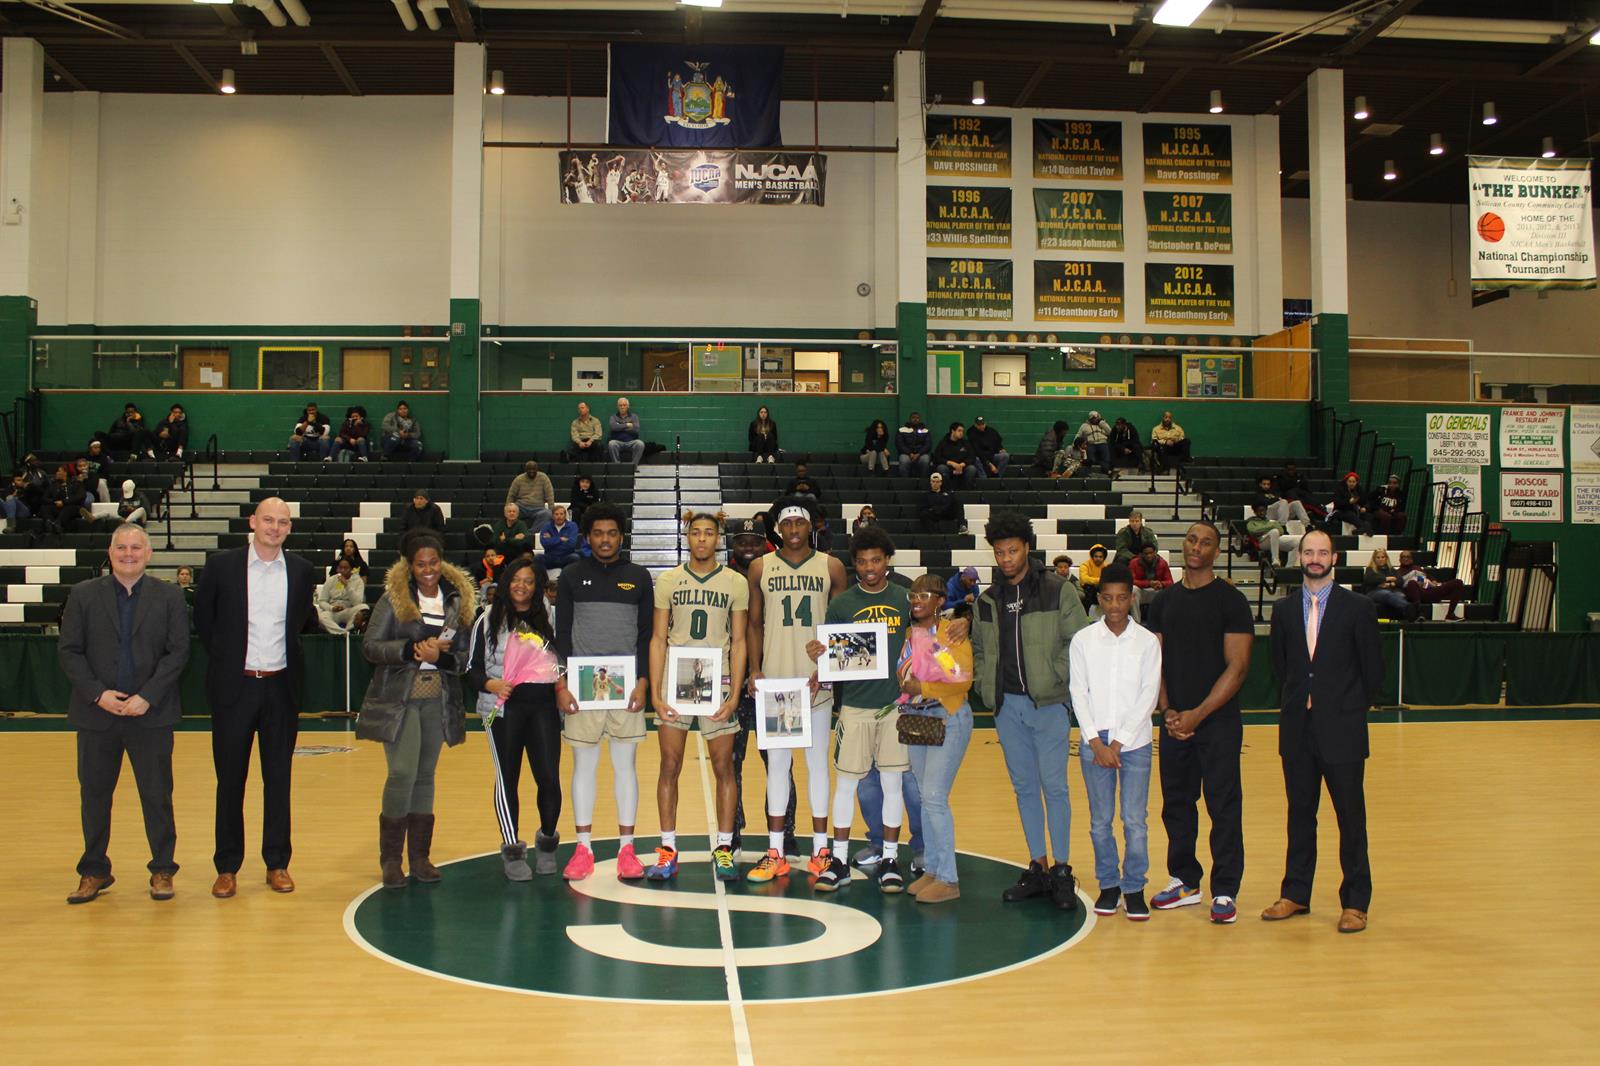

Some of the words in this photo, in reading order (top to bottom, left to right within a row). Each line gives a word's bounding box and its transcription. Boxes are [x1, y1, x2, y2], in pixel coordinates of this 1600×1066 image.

[953, 118, 980, 130] 1992
[1064, 122, 1092, 134] 1993
[1174, 128, 1201, 140] 1995
[735, 164, 818, 180] NJCAA
[934, 162, 954, 170] DAVE
[955, 162, 998, 172] POSSINGER
[1058, 165, 1087, 175] Donald
[1089, 166, 1115, 176] Taylor
[1157, 170, 1177, 179] Dave
[1179, 170, 1220, 181] Possinger
[735, 181, 762, 189] MEN'S
[952, 190, 980, 203] 1996
[1063, 192, 1094, 204] 2007
[1173, 195, 1204, 208] 2007
[1504, 200, 1525, 208] County
[943, 234, 968, 243] Willie
[969, 234, 1008, 244] Spellman
[1059, 239, 1082, 247] Jason
[1083, 239, 1116, 248] Johnson
[1478, 251, 1518, 261] National
[1521, 252, 1588, 263] Championship
[951, 260, 983, 273] 2008
[1065, 263, 1092, 276] 2011
[1506, 264, 1566, 274] Tournament
[1175, 267, 1203, 279] 2012
[1038, 308, 1051, 316] #11
[1053, 307, 1098, 317] Cleanthony
[1099, 308, 1118, 318] Early
[1150, 310, 1162, 318] #11
[1164, 310, 1207, 320] Cleanthony
[1209, 311, 1228, 320] Early
[1430, 416, 1443, 430] GO
[1447, 416, 1488, 430] GENERALS
[1515, 478, 1548, 486] ROSCOE
[1504, 489, 1536, 497] LUMBER
[1538, 489, 1559, 497] YARD
[768, 575, 824, 593] SULLIVAN
[672, 589, 730, 608] SULLIVAN
[781, 595, 812, 627] 14
[690, 609, 708, 640] 0
